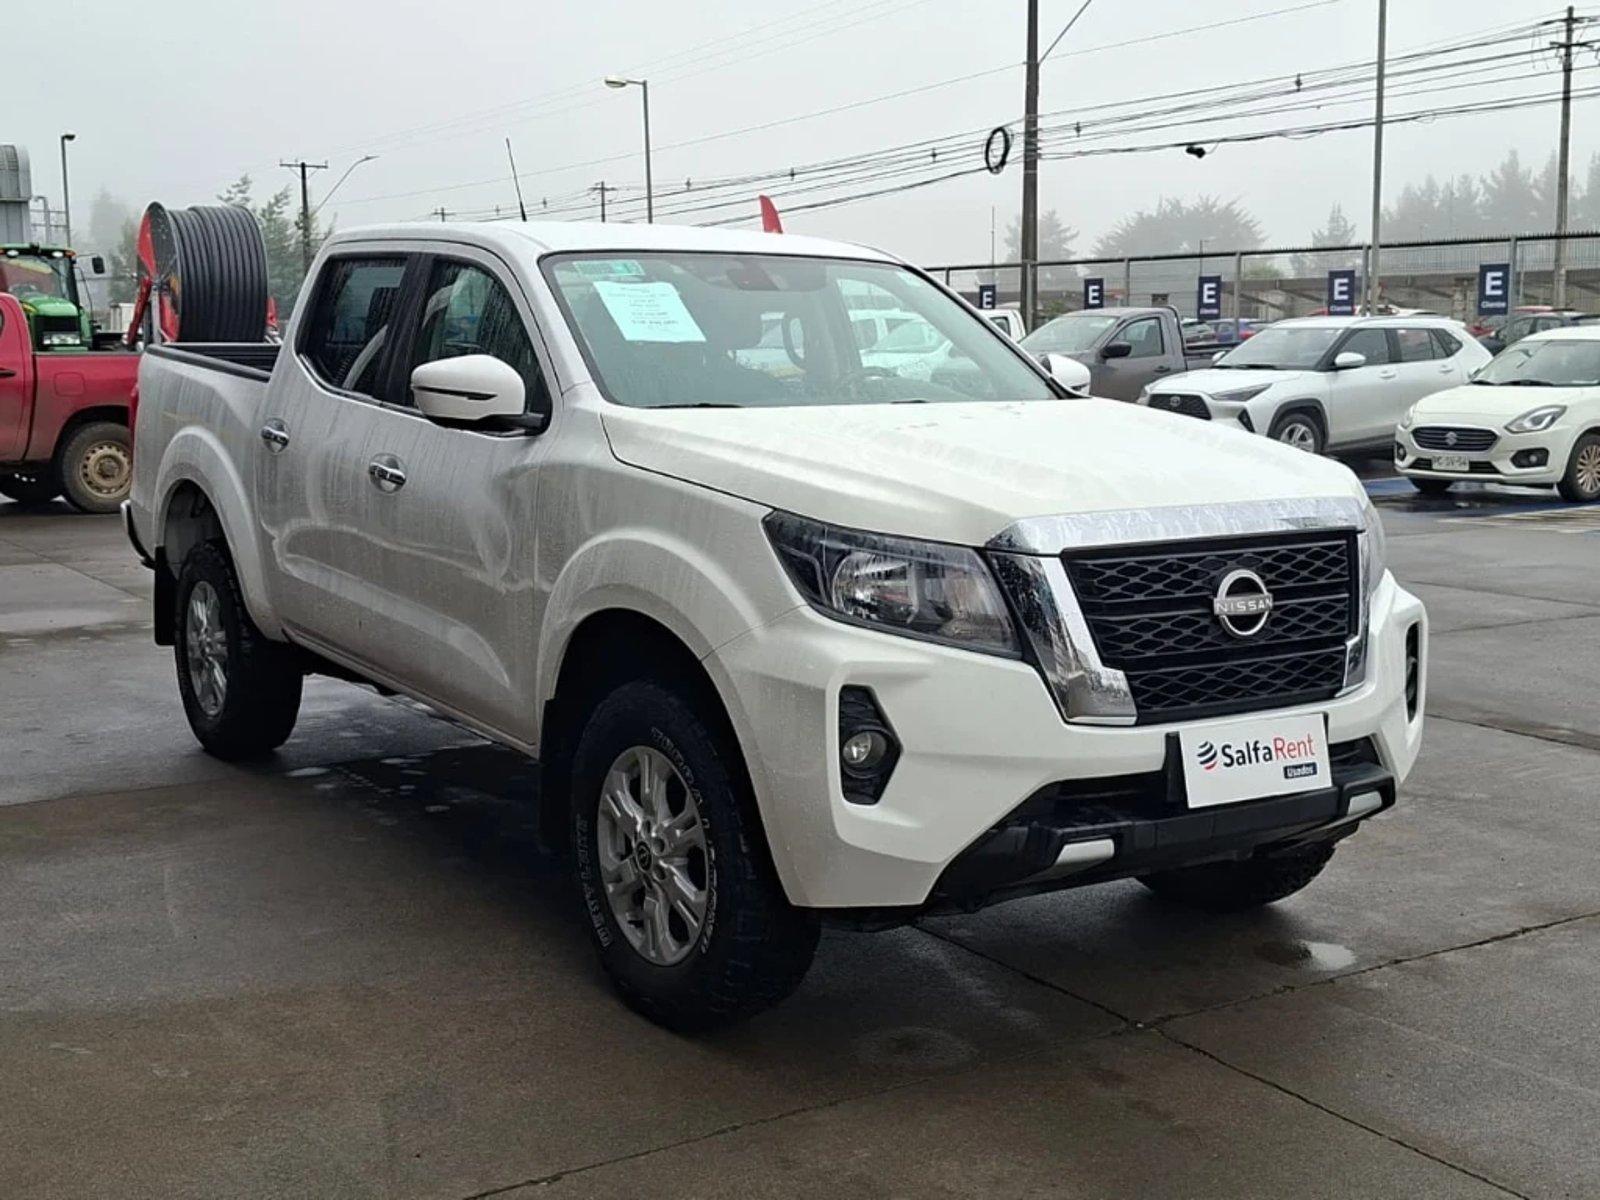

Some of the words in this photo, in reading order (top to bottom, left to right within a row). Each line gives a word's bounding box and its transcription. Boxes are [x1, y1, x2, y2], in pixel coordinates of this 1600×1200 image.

[1088, 284, 1101, 305] E
[1202, 282, 1217, 304] E
[1333, 278, 1349, 301] E
[1485, 271, 1504, 296] E
[982, 290, 993, 309] E
[1216, 596, 1273, 613] NISSAN
[1221, 733, 1316, 768] SalfaRent
